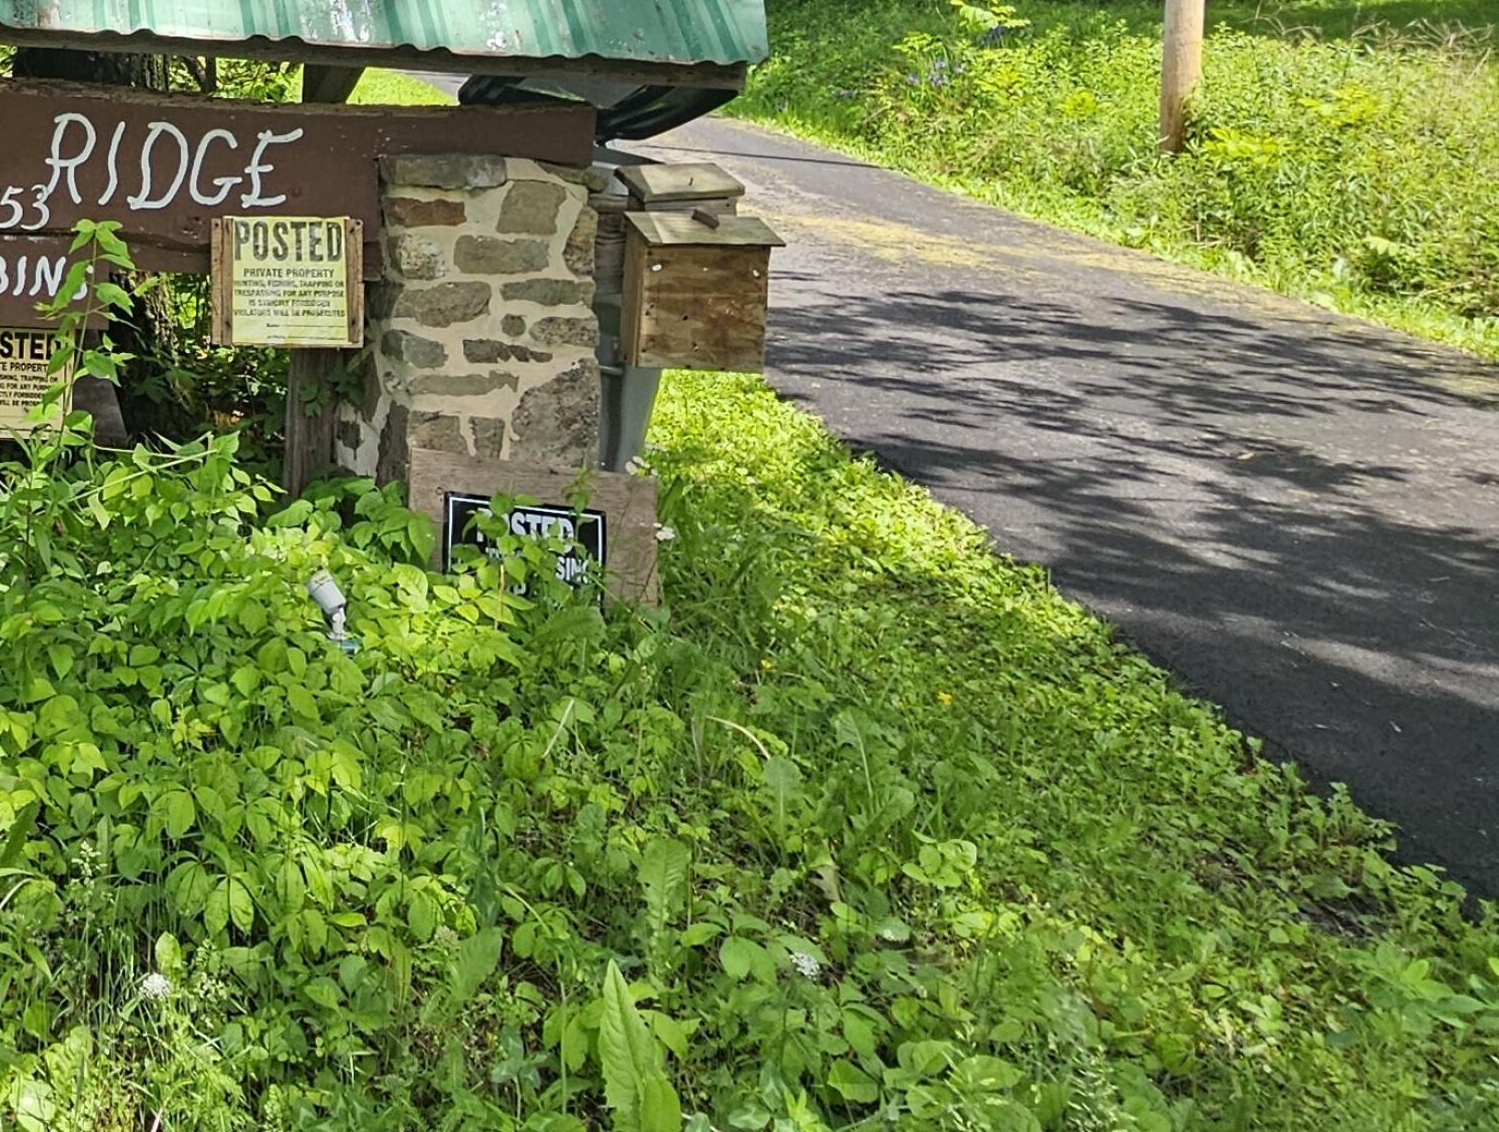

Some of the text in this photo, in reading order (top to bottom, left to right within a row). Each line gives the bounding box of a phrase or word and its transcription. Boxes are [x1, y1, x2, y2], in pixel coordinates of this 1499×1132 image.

[43, 111, 304, 210] RIDGE
[234, 221, 343, 262] POSTED
[243, 268, 334, 278] PRIVATE PROPERTY
[10, 362, 49, 372] PROPERT
[476, 508, 575, 554] PSTED
